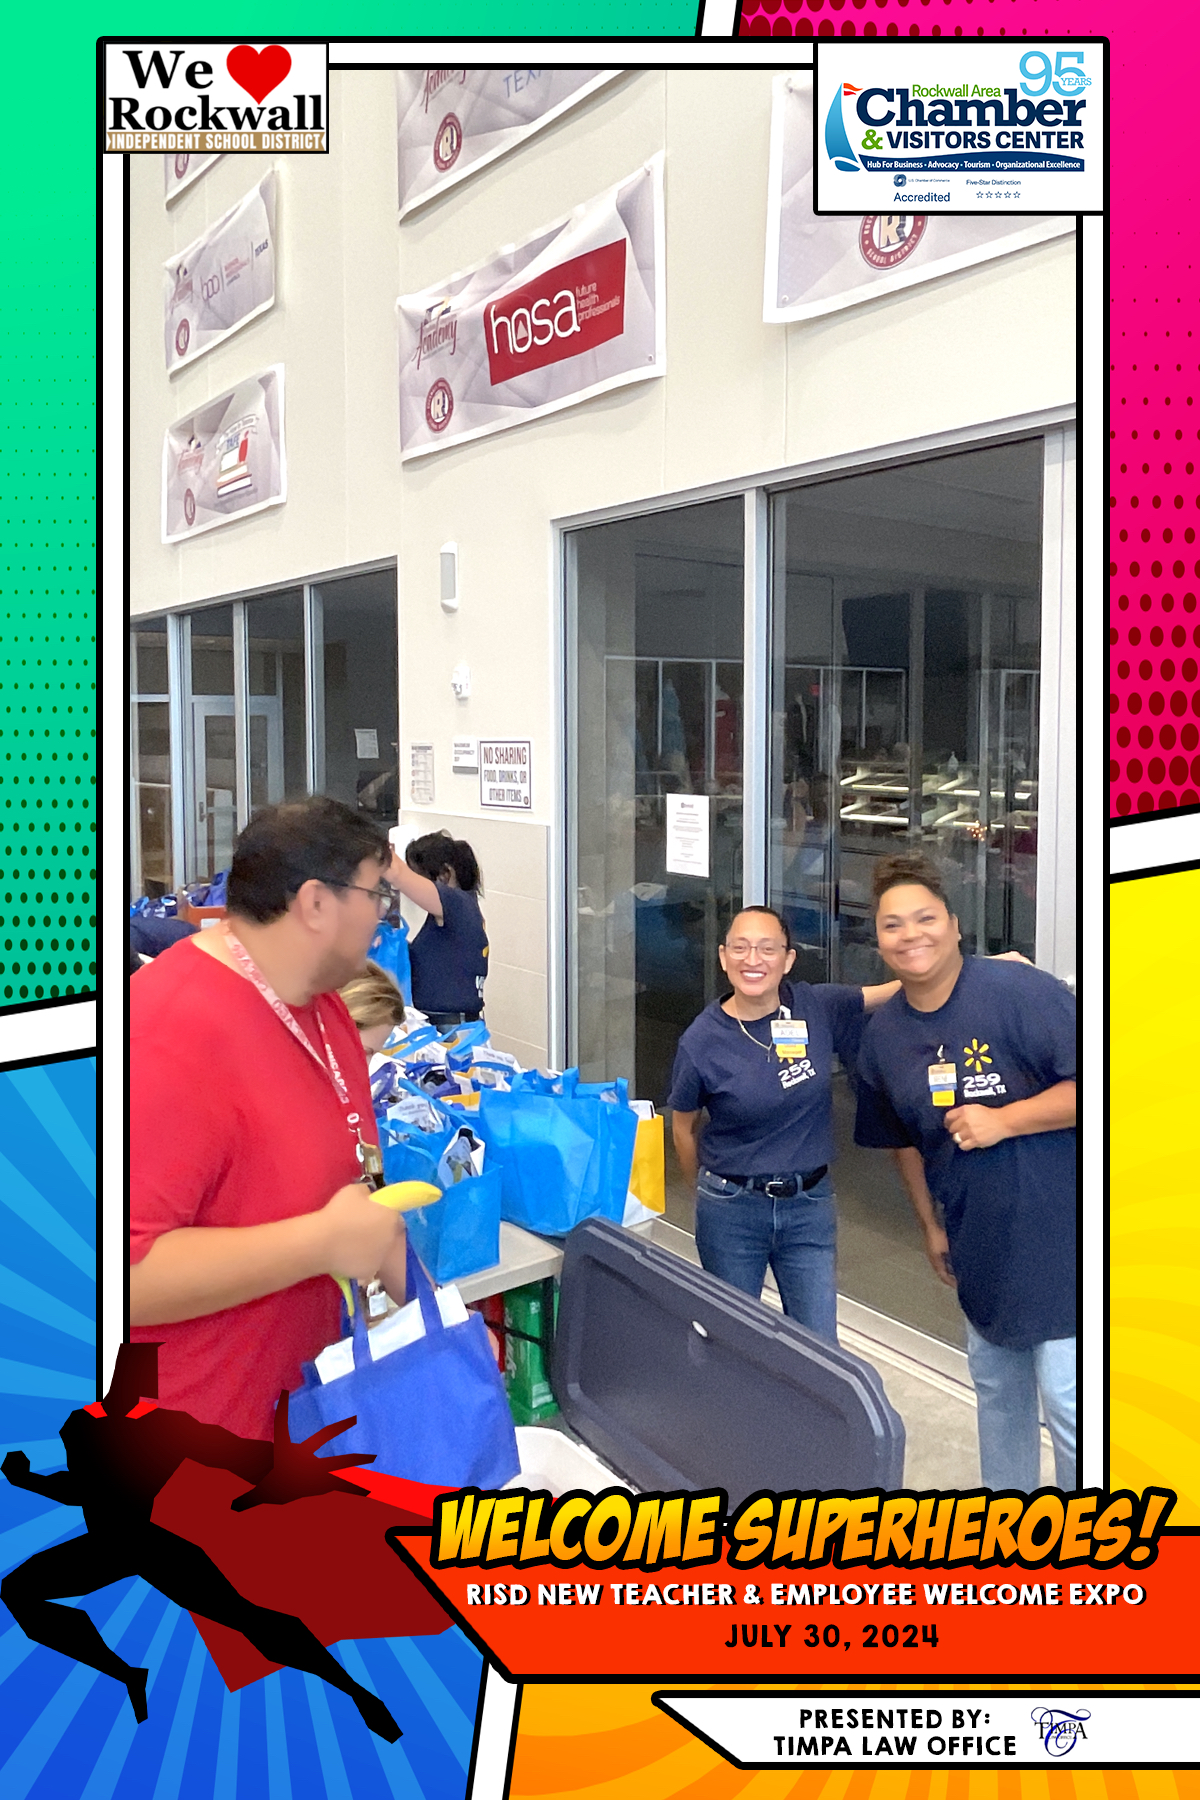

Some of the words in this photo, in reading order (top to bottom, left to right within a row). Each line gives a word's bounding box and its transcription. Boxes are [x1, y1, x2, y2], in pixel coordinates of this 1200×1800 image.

[503, 70, 542, 98] TEX
[576, 282, 597, 297] future
[577, 293, 599, 309] health
[578, 295, 620, 324] professionals
[490, 289, 580, 354] hosa
[484, 747, 493, 764] NO
[495, 747, 527, 764] SHARING
[484, 770, 498, 783] FOOD,
[499, 770, 519, 785] DRINKS,
[520, 770, 527, 784] OR
[489, 788, 505, 801] OTHER
[506, 789, 521, 802] ITEMS
[778, 1059, 811, 1081] 259
[962, 1072, 1001, 1088] 259
